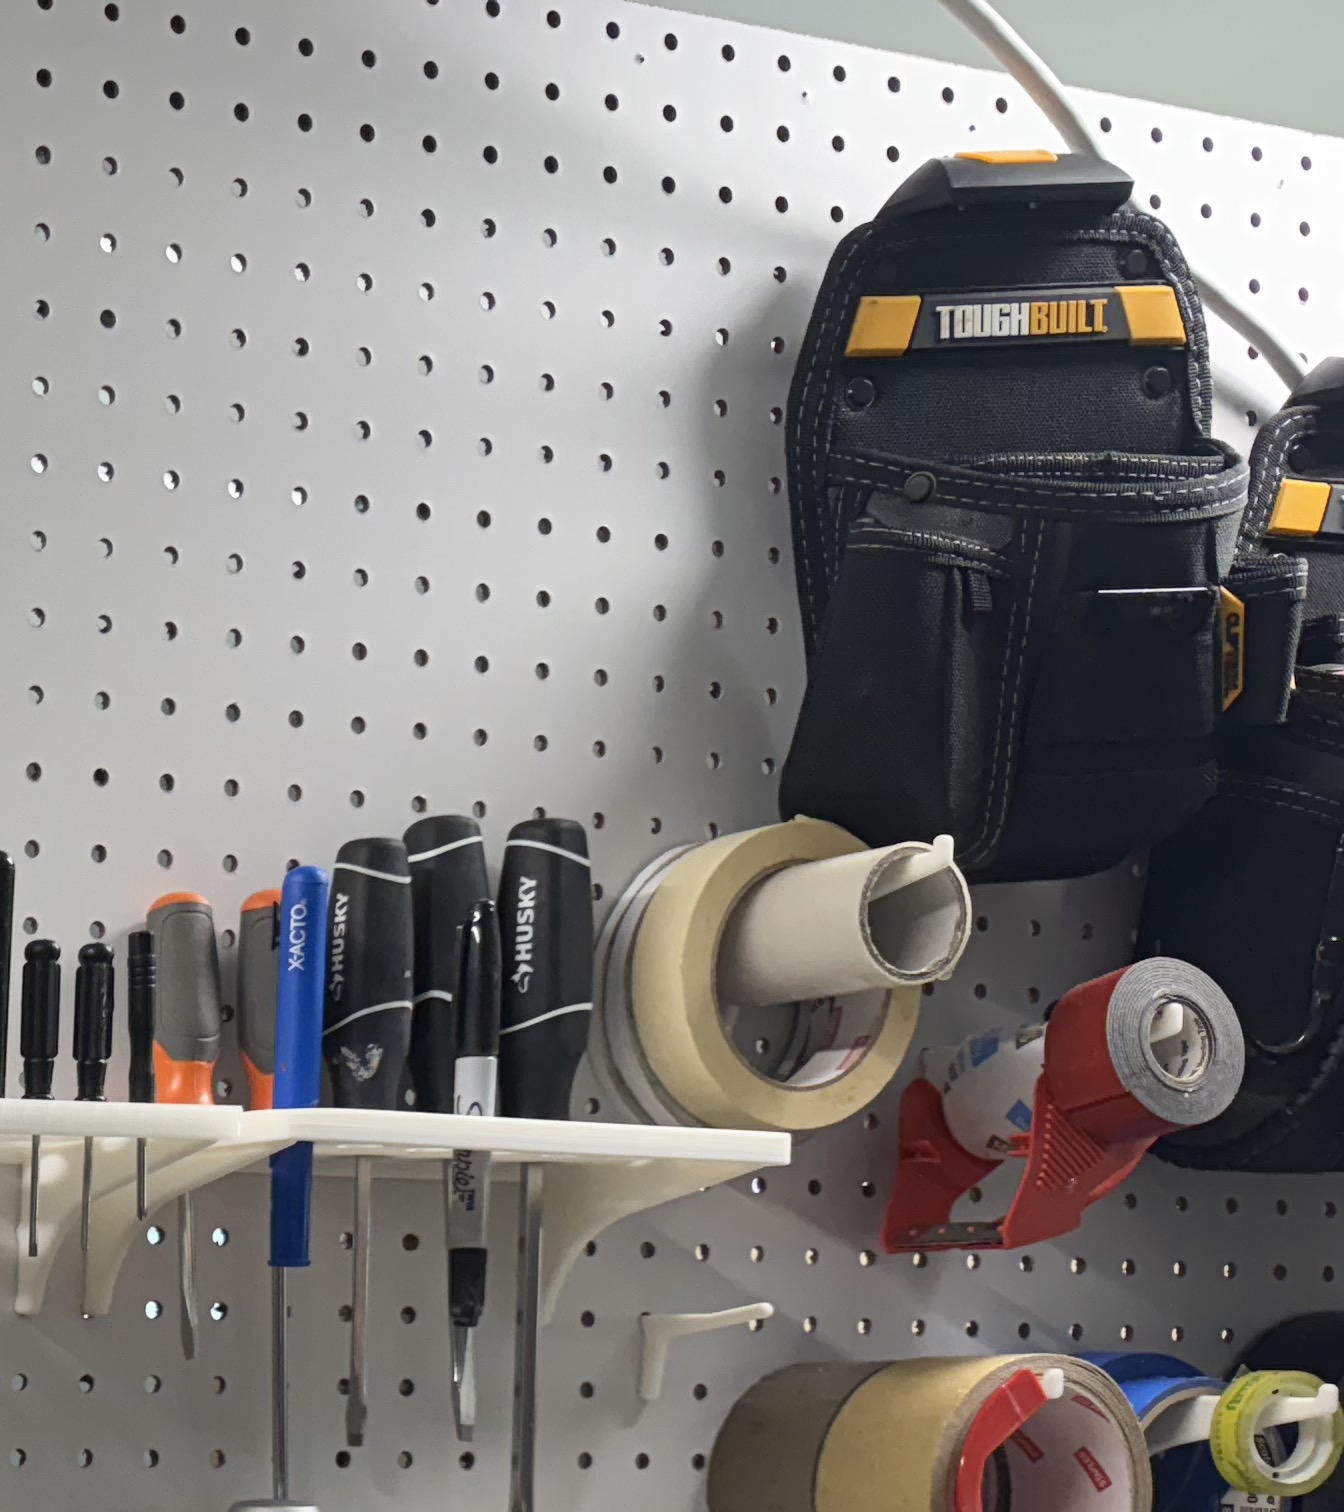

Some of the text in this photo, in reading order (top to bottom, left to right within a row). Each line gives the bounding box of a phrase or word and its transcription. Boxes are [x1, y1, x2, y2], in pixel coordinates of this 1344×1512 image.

[935, 299, 1108, 340] TOUGHBUILT
[288, 899, 308, 972] X-ACTO
[330, 893, 350, 973] HUSKY
[515, 875, 538, 962] HUSKY
